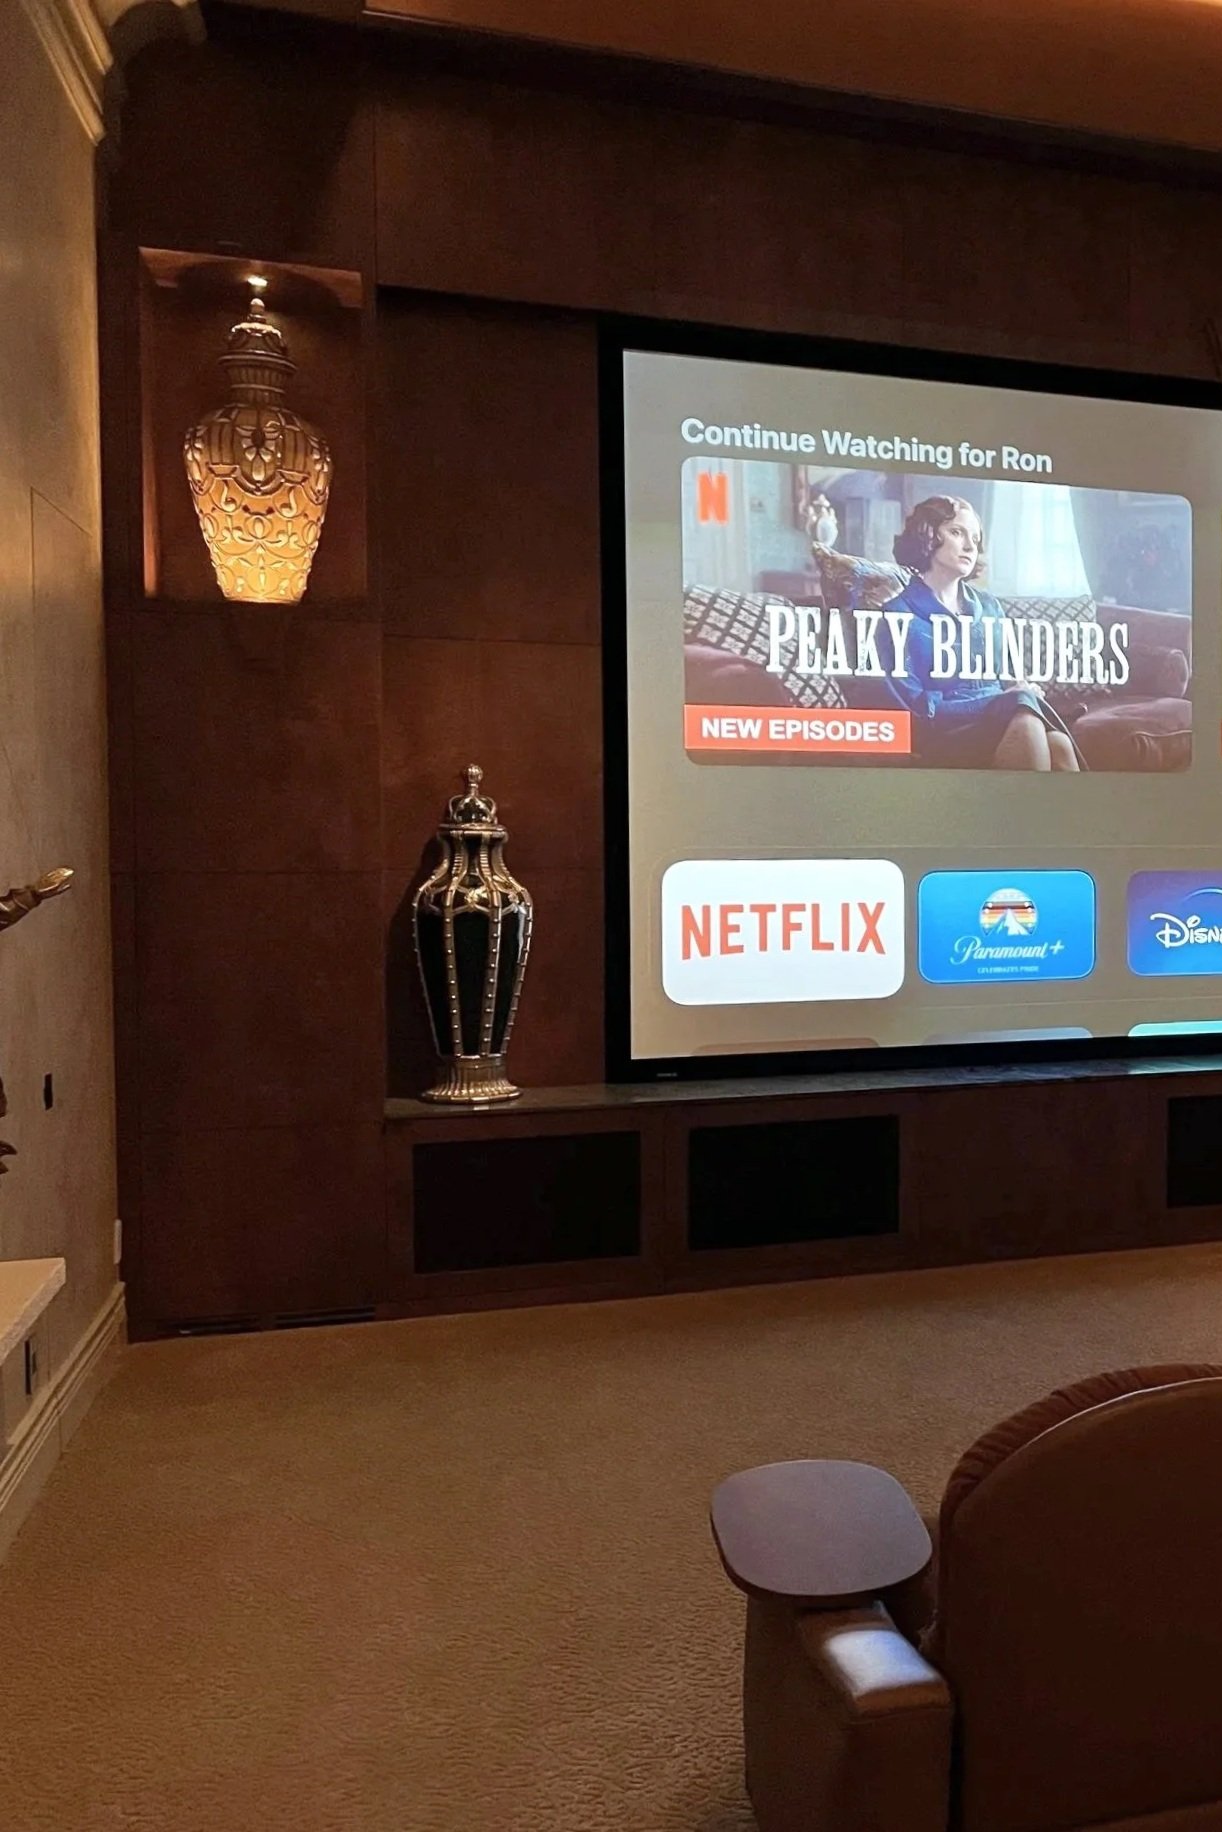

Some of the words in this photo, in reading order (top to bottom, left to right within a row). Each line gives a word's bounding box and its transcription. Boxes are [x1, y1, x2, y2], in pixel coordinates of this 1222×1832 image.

[681, 418, 816, 454] Continue
[822, 430, 953, 469] Watching
[958, 442, 996, 468] for
[1002, 446, 1053, 473] Ron
[697, 472, 729, 524] N
[765, 604, 914, 679] PEAKY
[930, 614, 1130, 685] BLINDERS
[701, 717, 766, 740] NEW
[768, 718, 895, 743] EPISODES
[681, 901, 886, 960] NETFLIX
